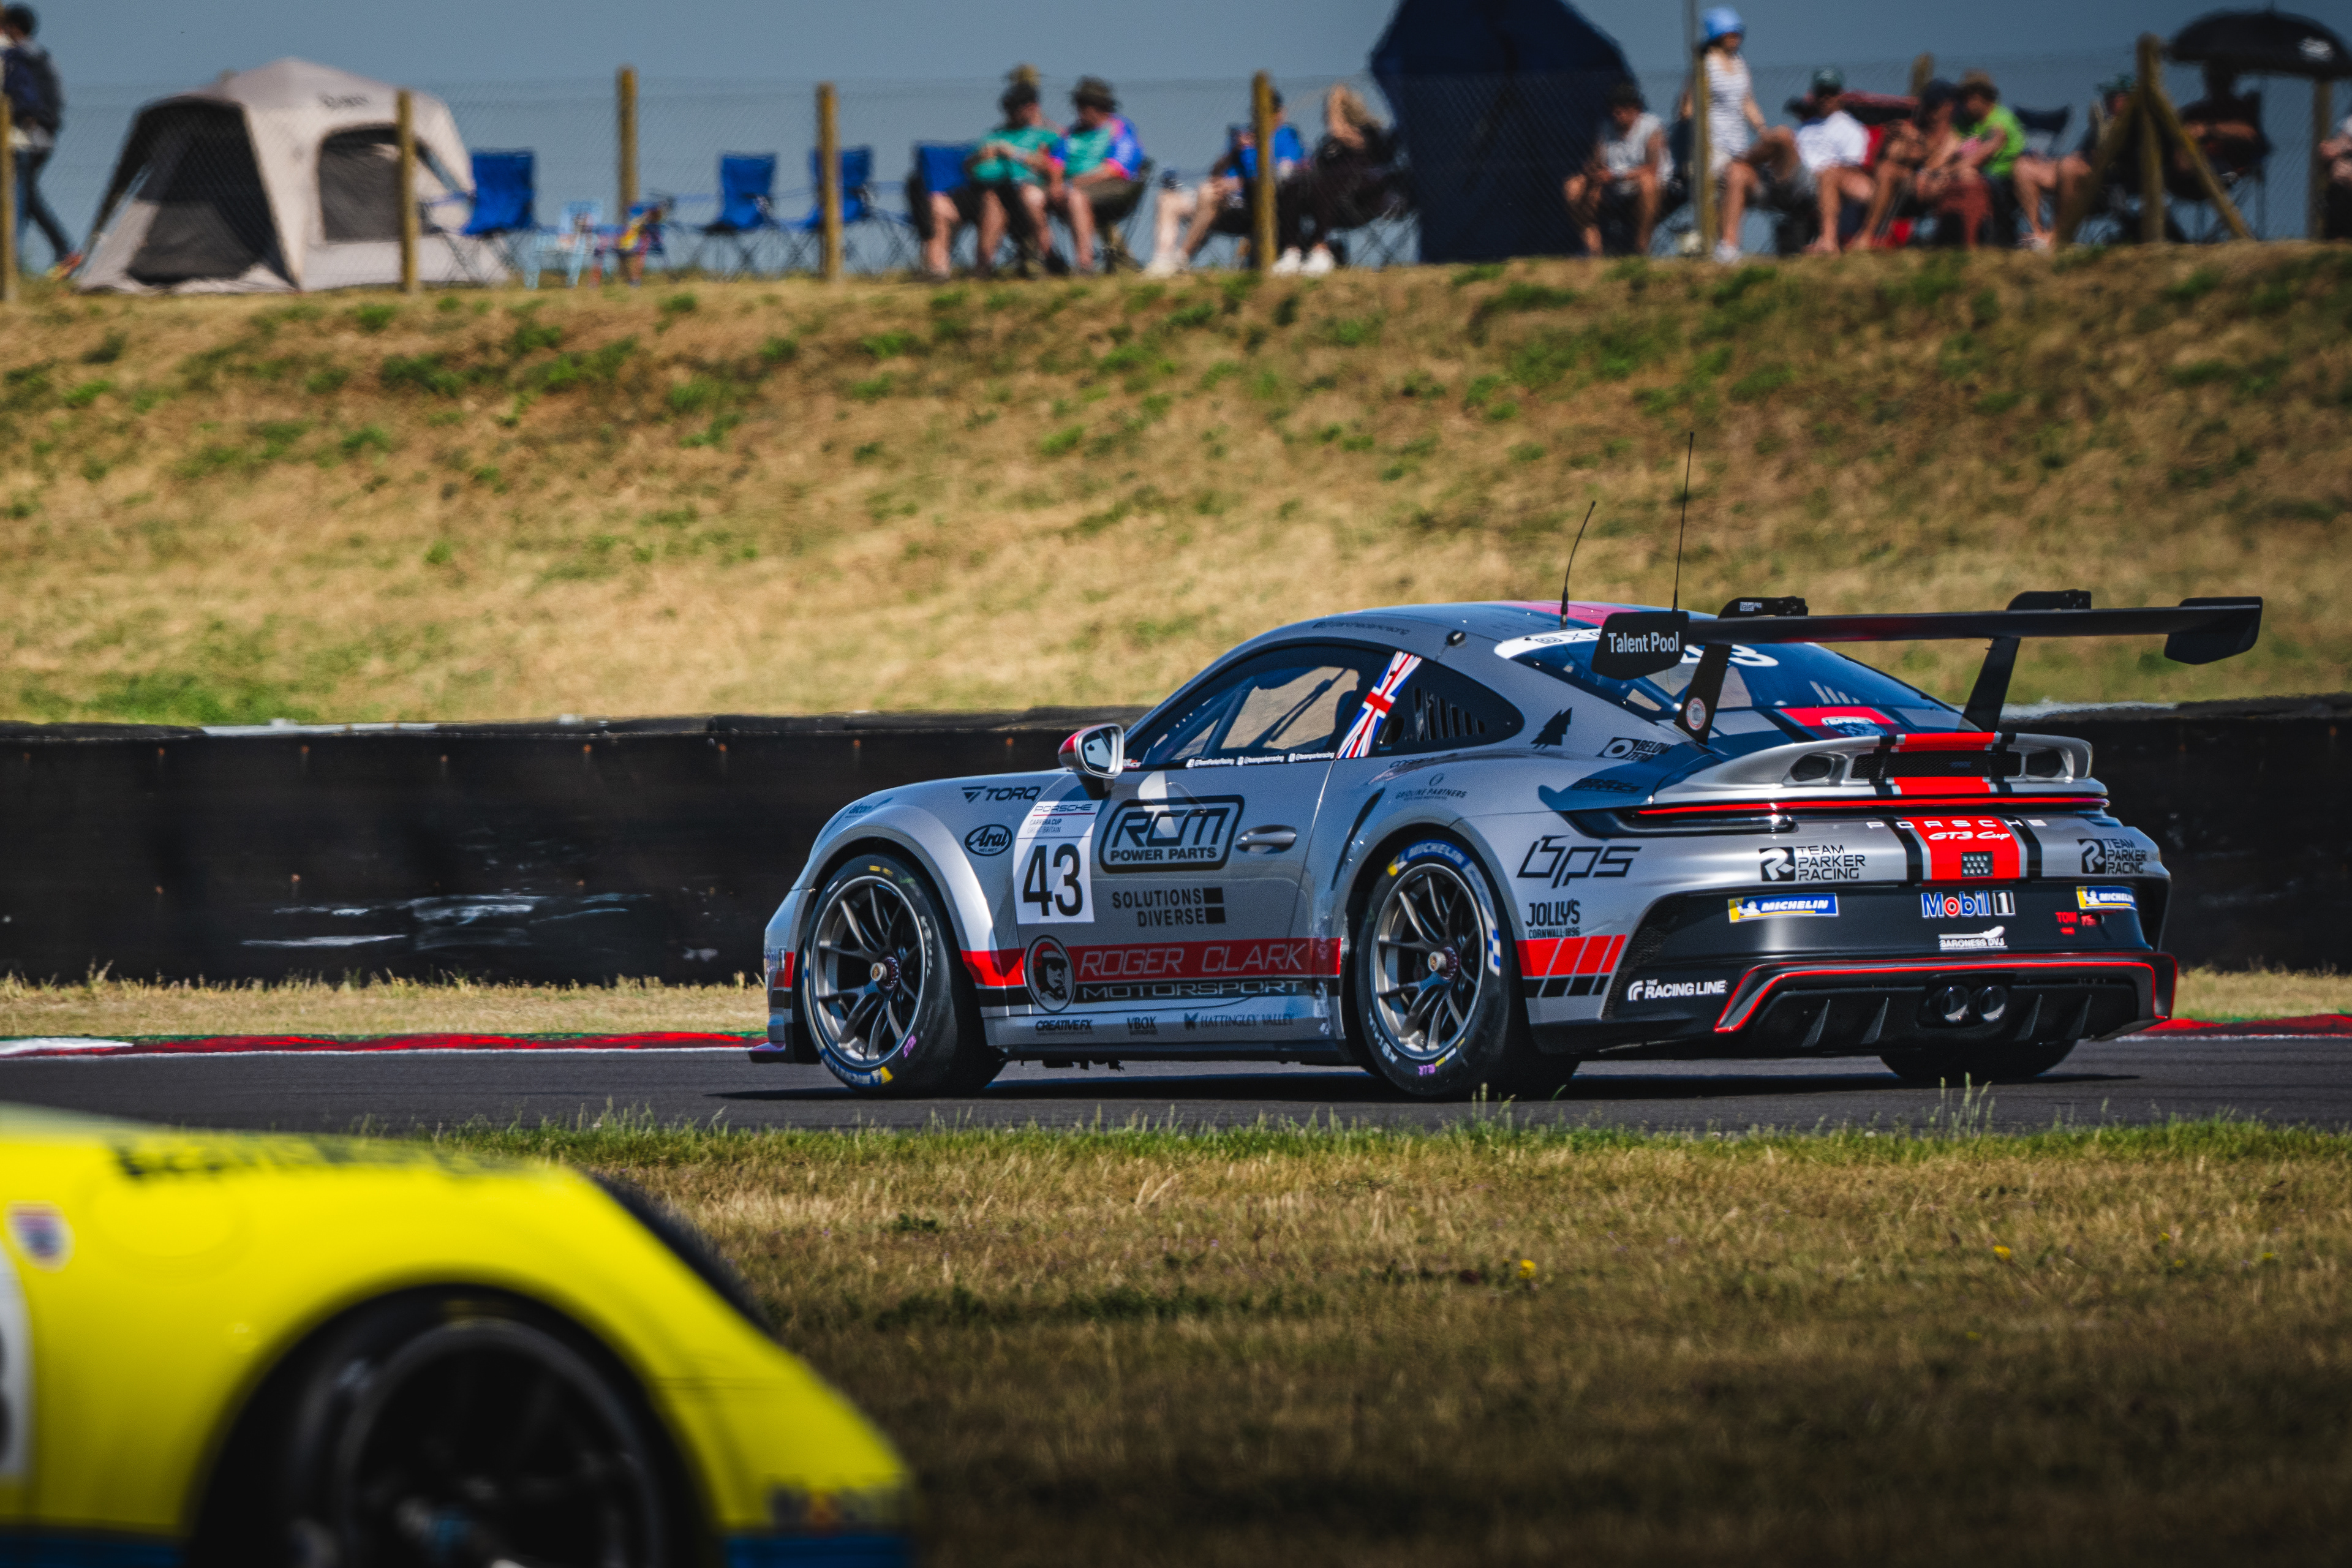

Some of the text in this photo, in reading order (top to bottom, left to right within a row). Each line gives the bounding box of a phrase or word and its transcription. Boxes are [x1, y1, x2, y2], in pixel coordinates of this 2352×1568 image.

[1607, 631, 1679, 653] Talent Pool
[986, 786, 1041, 802] TORQ
[1034, 804, 1093, 813] PORSCHE
[1112, 807, 1230, 848] RCM
[1866, 819, 2048, 829] PORSCHE
[965, 827, 1008, 847] Arai
[1928, 831, 2011, 840] GT3 Cup
[1795, 844, 1845, 856] TEAM
[2103, 839, 2136, 848] TEAM
[1110, 846, 1217, 862] POWER PARTS
[2107, 850, 2147, 862] PARKER
[1798, 854, 1866, 869] PARKER
[2107, 862, 2145, 875] RACING
[1022, 843, 1084, 917] 43
[1798, 867, 1860, 881] RACING
[1112, 888, 1202, 909] SOLUTIONS
[1920, 890, 1991, 919] Mobil
[2098, 892, 2135, 903] MICHELIN
[1525, 898, 1581, 927] JOLLY'S
[1760, 900, 1829, 911] MICHELIN
[1137, 907, 1205, 927] DIVERSE
[2055, 911, 2078, 924] TOW
[1939, 939, 1988, 948] BARONESS
[1079, 943, 1306, 977] ROGER CLARK
[1082, 980, 1303, 1000] MOTORSPORT
[1644, 980, 1727, 1000] RACING LINE
[1035, 1019, 1093, 1031] CREATIVEFX
[1126, 1016, 1157, 1030] VBOX
